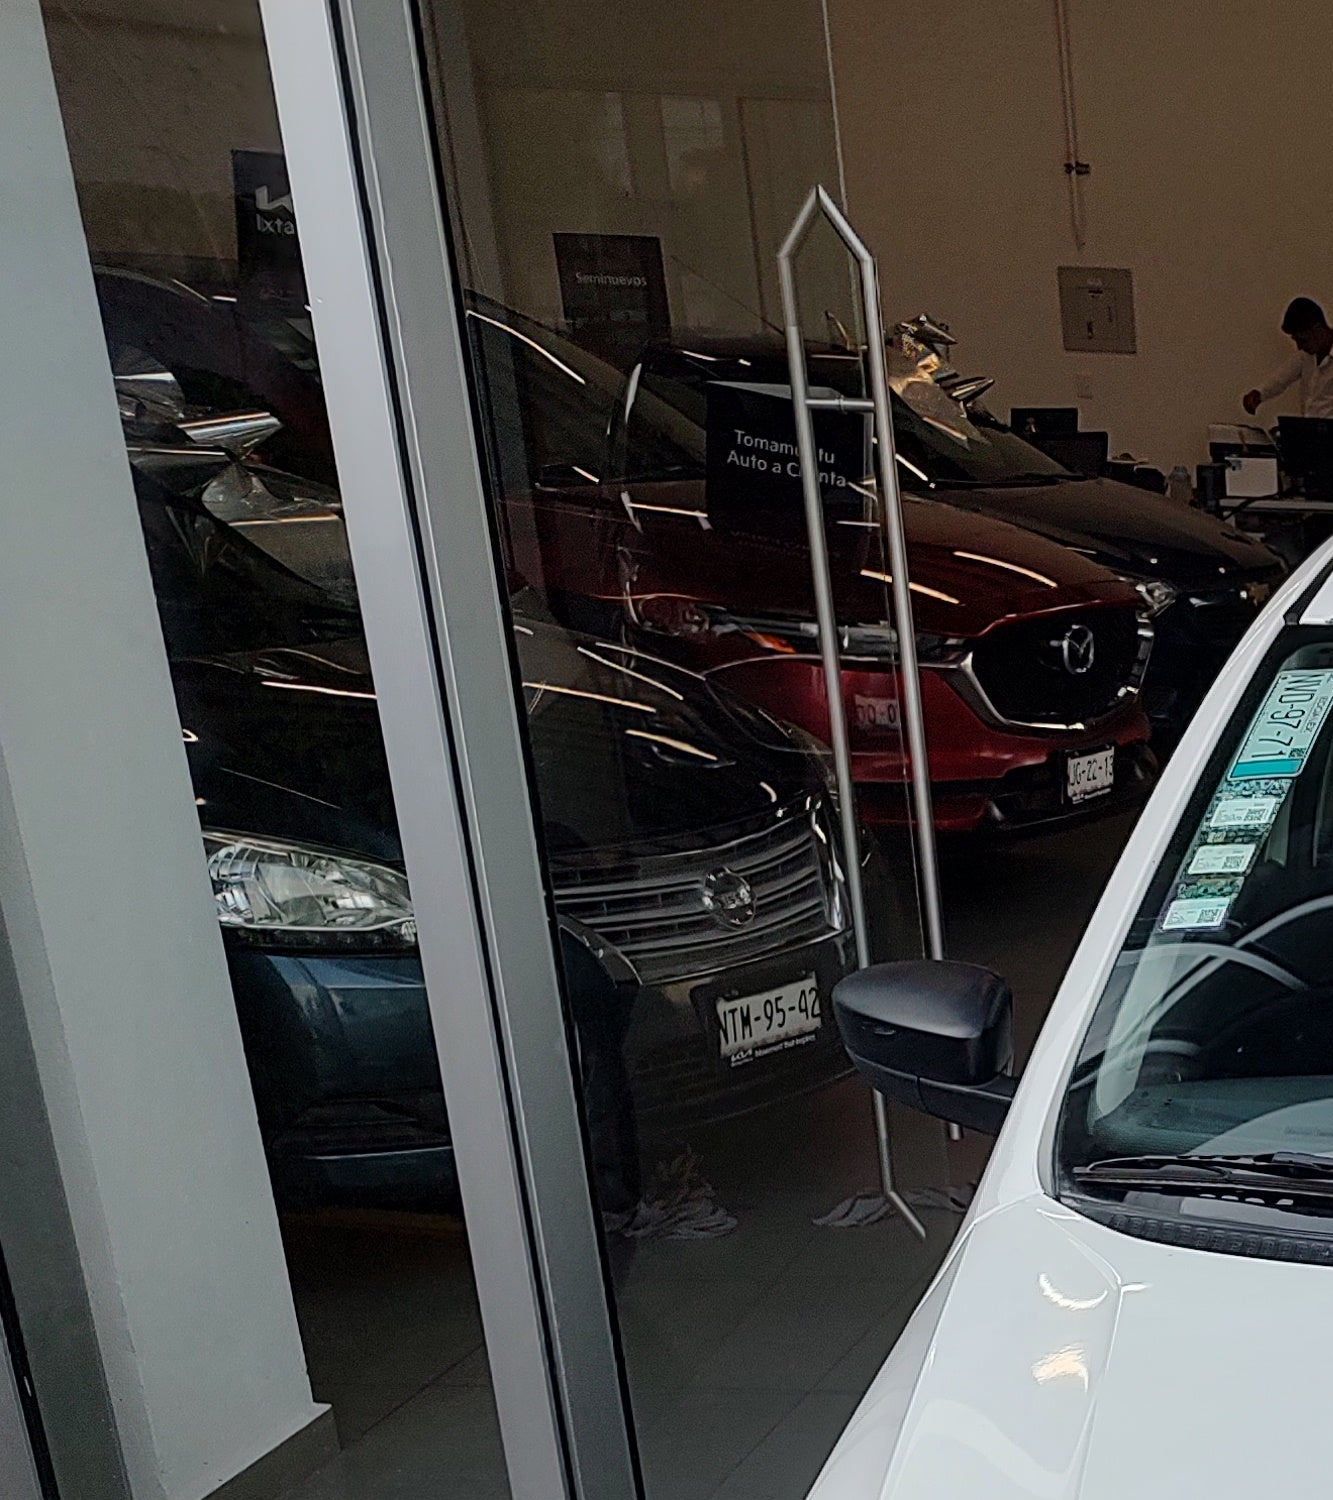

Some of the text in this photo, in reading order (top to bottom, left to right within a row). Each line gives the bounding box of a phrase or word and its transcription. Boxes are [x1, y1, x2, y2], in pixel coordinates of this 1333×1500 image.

[734, 429, 835, 465] Tomam tu
[727, 450, 847, 488] Auto a Cnta
